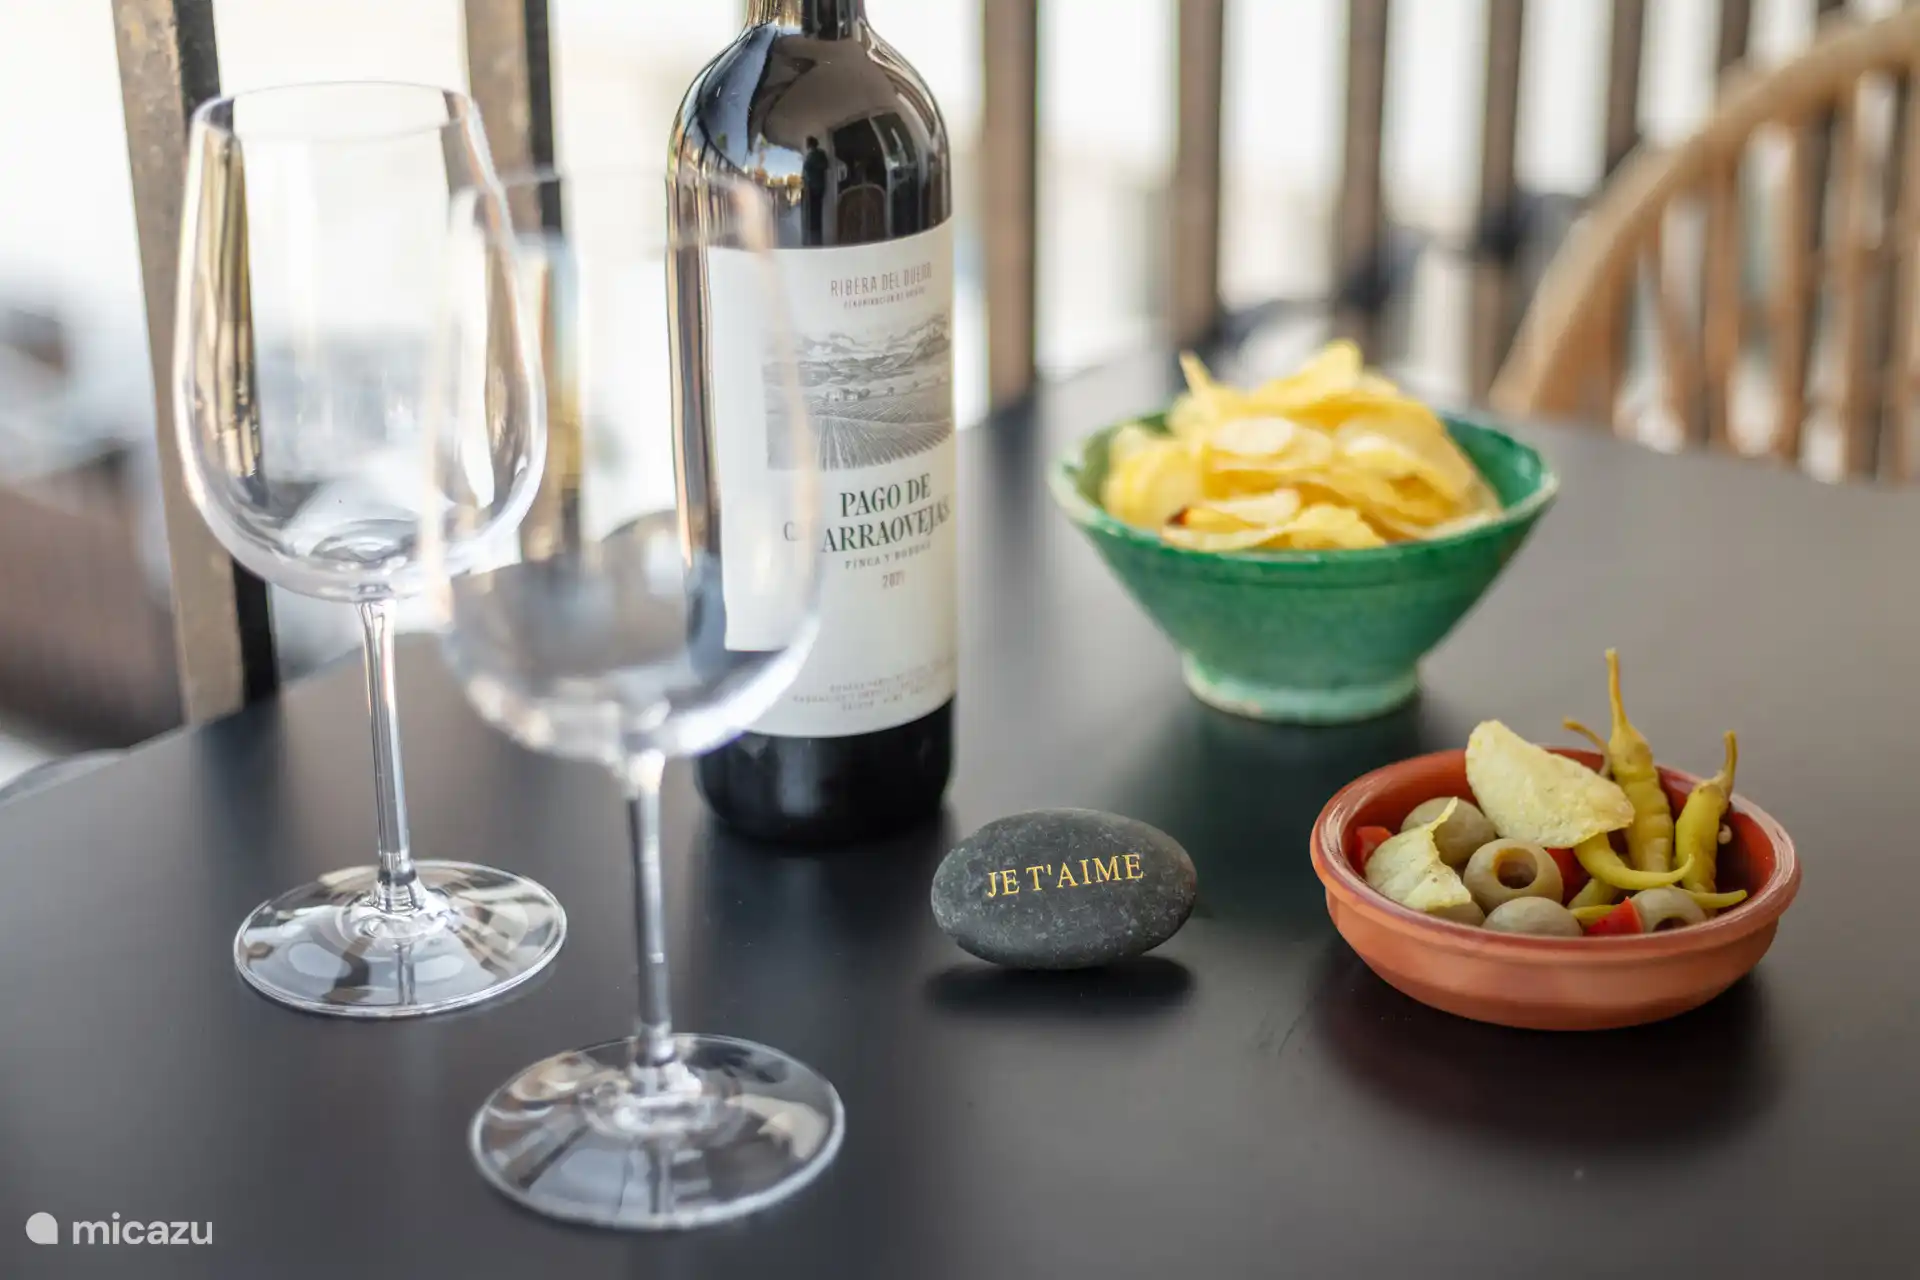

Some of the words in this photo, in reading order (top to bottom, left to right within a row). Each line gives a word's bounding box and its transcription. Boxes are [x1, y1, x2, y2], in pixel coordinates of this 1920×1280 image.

[830, 275, 878, 298] RIBERA
[881, 271, 900, 291] DEL
[840, 484, 901, 518] PAGO
[905, 473, 931, 504] DE
[845, 558, 881, 571] FINCA
[884, 555, 891, 564] Y
[987, 869, 1020, 898] JE
[1025, 853, 1145, 892] T'AIME
